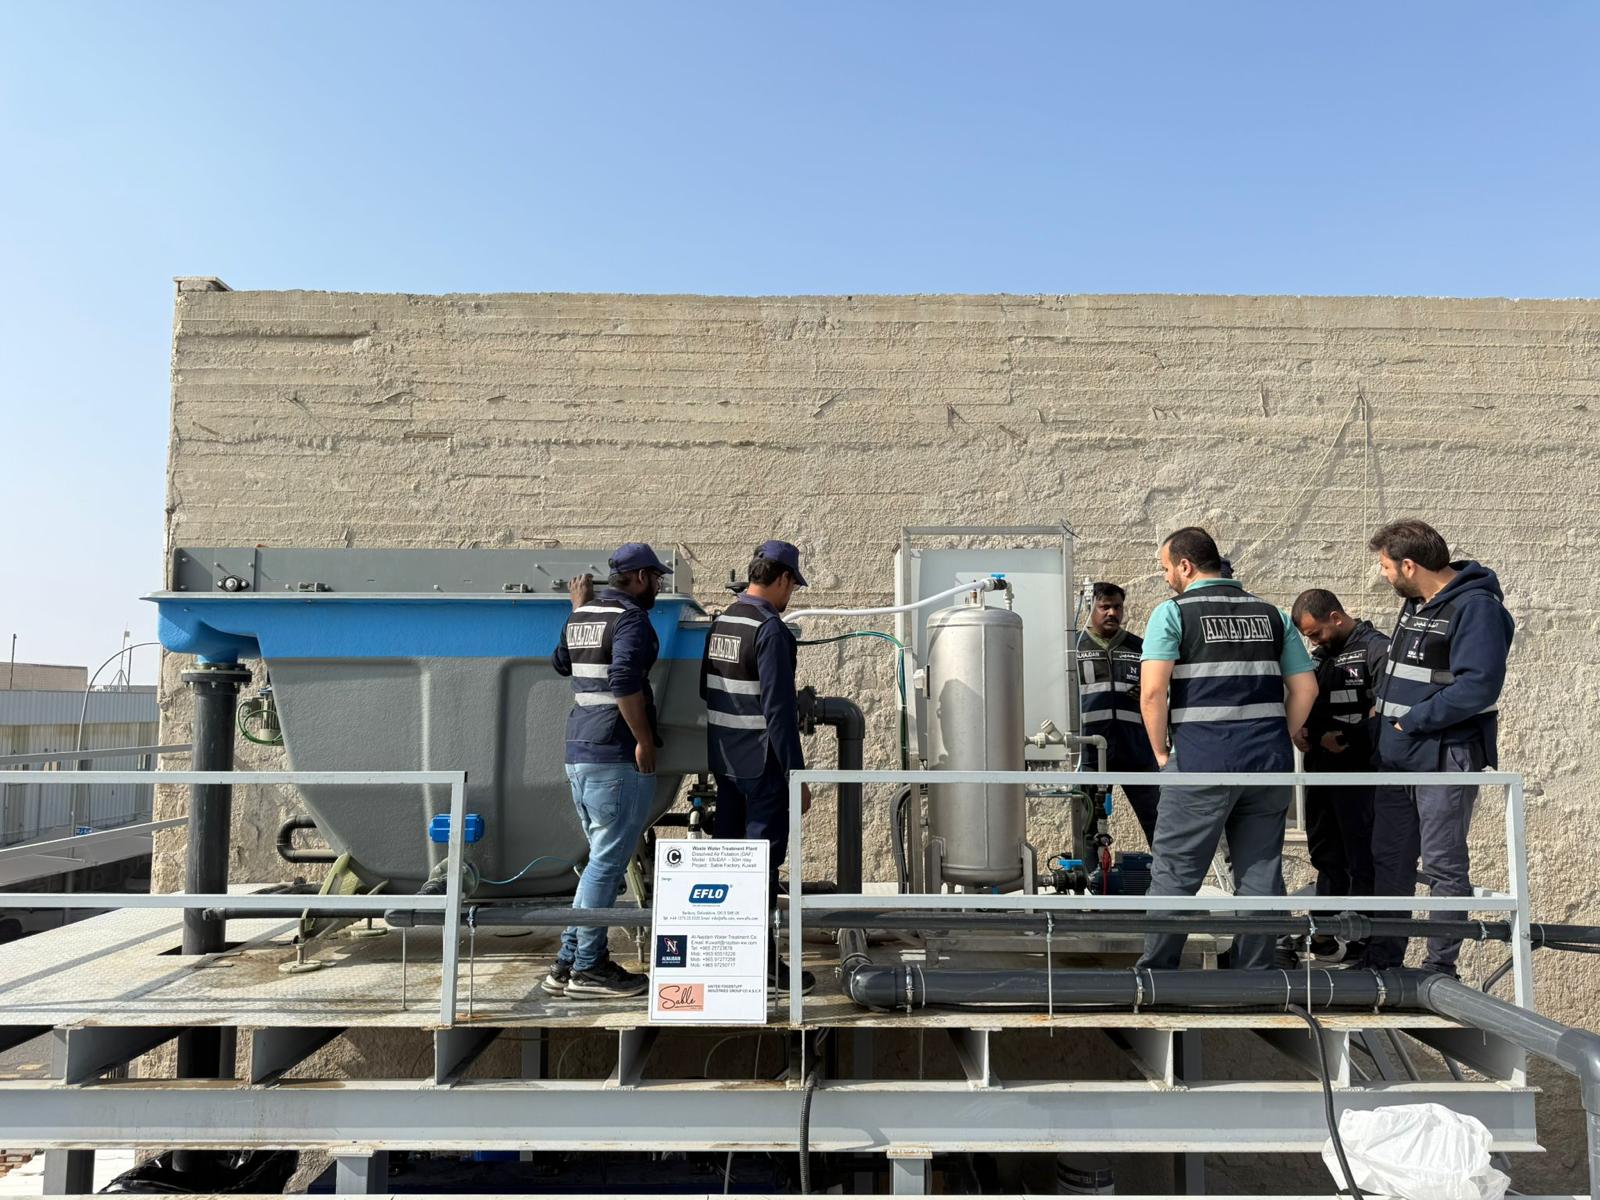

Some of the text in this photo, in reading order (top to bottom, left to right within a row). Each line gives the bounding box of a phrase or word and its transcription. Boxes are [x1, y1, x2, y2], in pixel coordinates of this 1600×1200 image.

[1206, 618, 1271, 640] ALNAJDAIN
[693, 889, 724, 898] EFLO
[666, 940, 678, 952] N
[659, 985, 696, 1010] Sable
